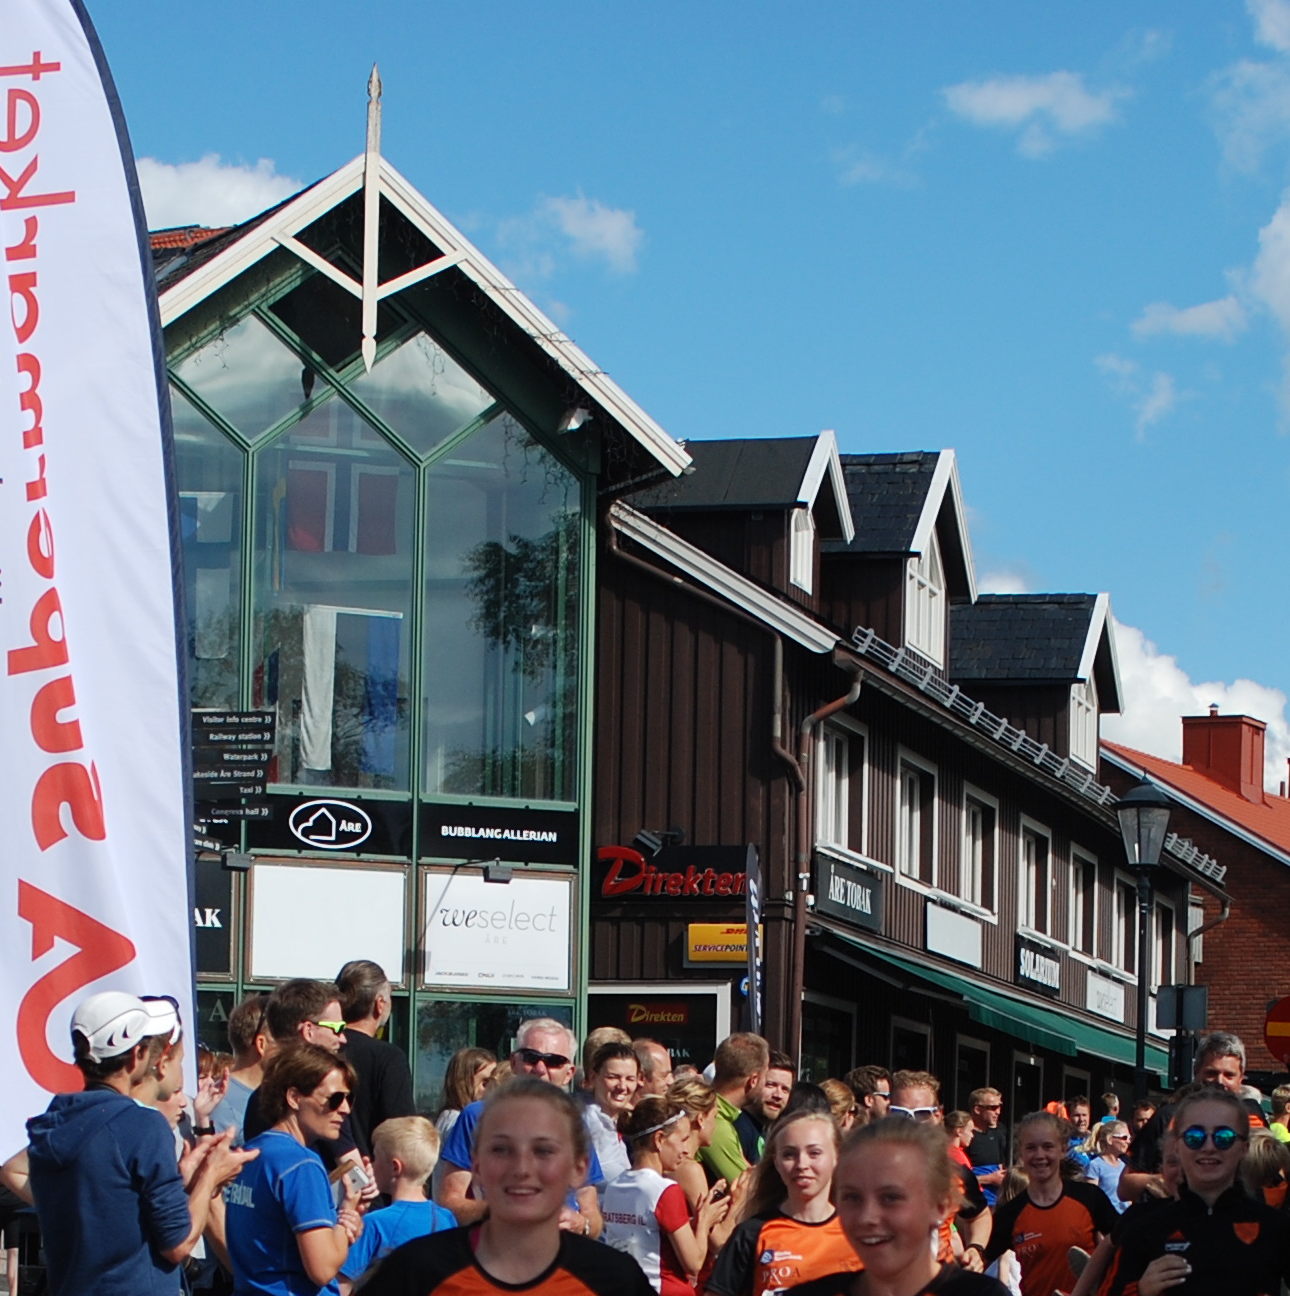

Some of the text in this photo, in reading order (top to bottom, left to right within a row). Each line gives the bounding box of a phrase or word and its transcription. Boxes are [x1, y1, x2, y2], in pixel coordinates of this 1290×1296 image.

[202, 716, 224, 724] Visitor
[209, 733, 236, 741] Railway
[223, 753, 259, 761] Waterpark
[193, 770, 218, 778] akeside
[239, 786, 254, 794] Taxi
[339, 820, 362, 832] ÅRE
[598, 846, 747, 896] Direkten
[828, 863, 872, 915] ÅRE TOBAK
[439, 899, 557, 932] weselect
[1020, 947, 1060, 989] SOLARIUM
[629, 1004, 685, 1023] Direkten
[602, 1212, 636, 1224] RATSBERG
